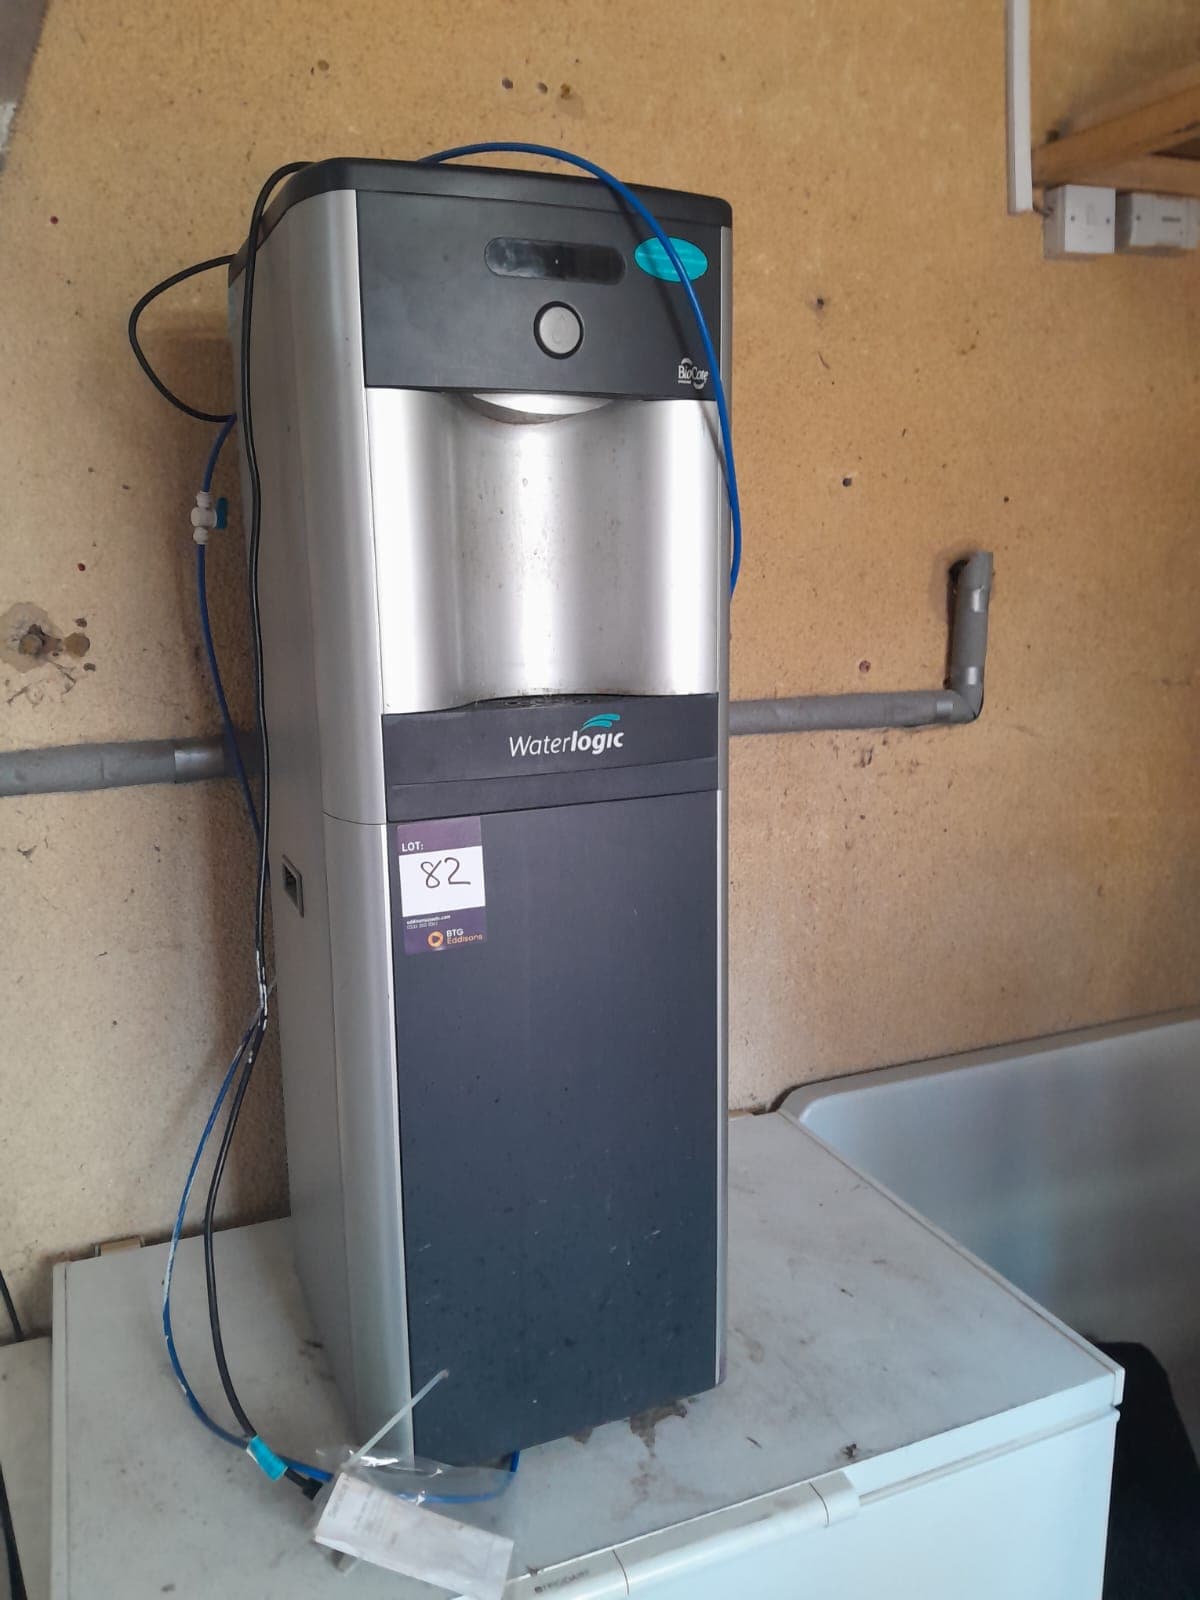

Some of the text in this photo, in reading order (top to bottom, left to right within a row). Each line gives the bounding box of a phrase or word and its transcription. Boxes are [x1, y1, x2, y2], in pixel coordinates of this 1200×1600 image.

[509, 730, 625, 757] Waterlogic
[401, 841, 424, 852] LOT:
[420, 856, 471, 889] 82
[446, 928, 464, 938] BTG
[447, 934, 483, 945] Eddisons
